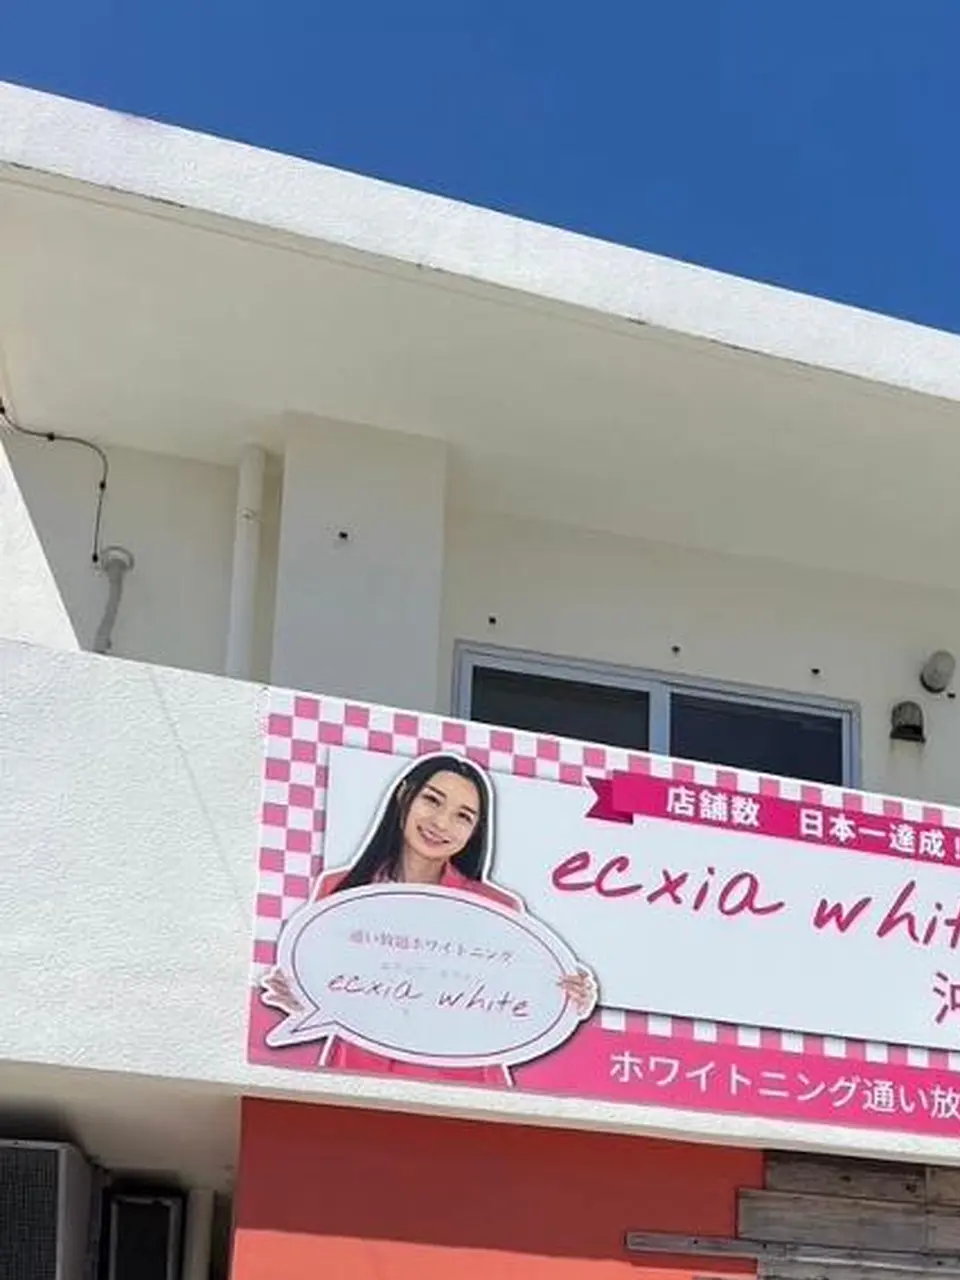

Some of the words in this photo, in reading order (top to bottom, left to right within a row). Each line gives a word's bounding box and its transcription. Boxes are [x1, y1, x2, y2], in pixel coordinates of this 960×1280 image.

[666, 786, 762, 828] 店舗数
[551, 849, 784, 917] ecxia
[328, 973, 423, 1001] ecxia
[437, 981, 531, 1019] white
